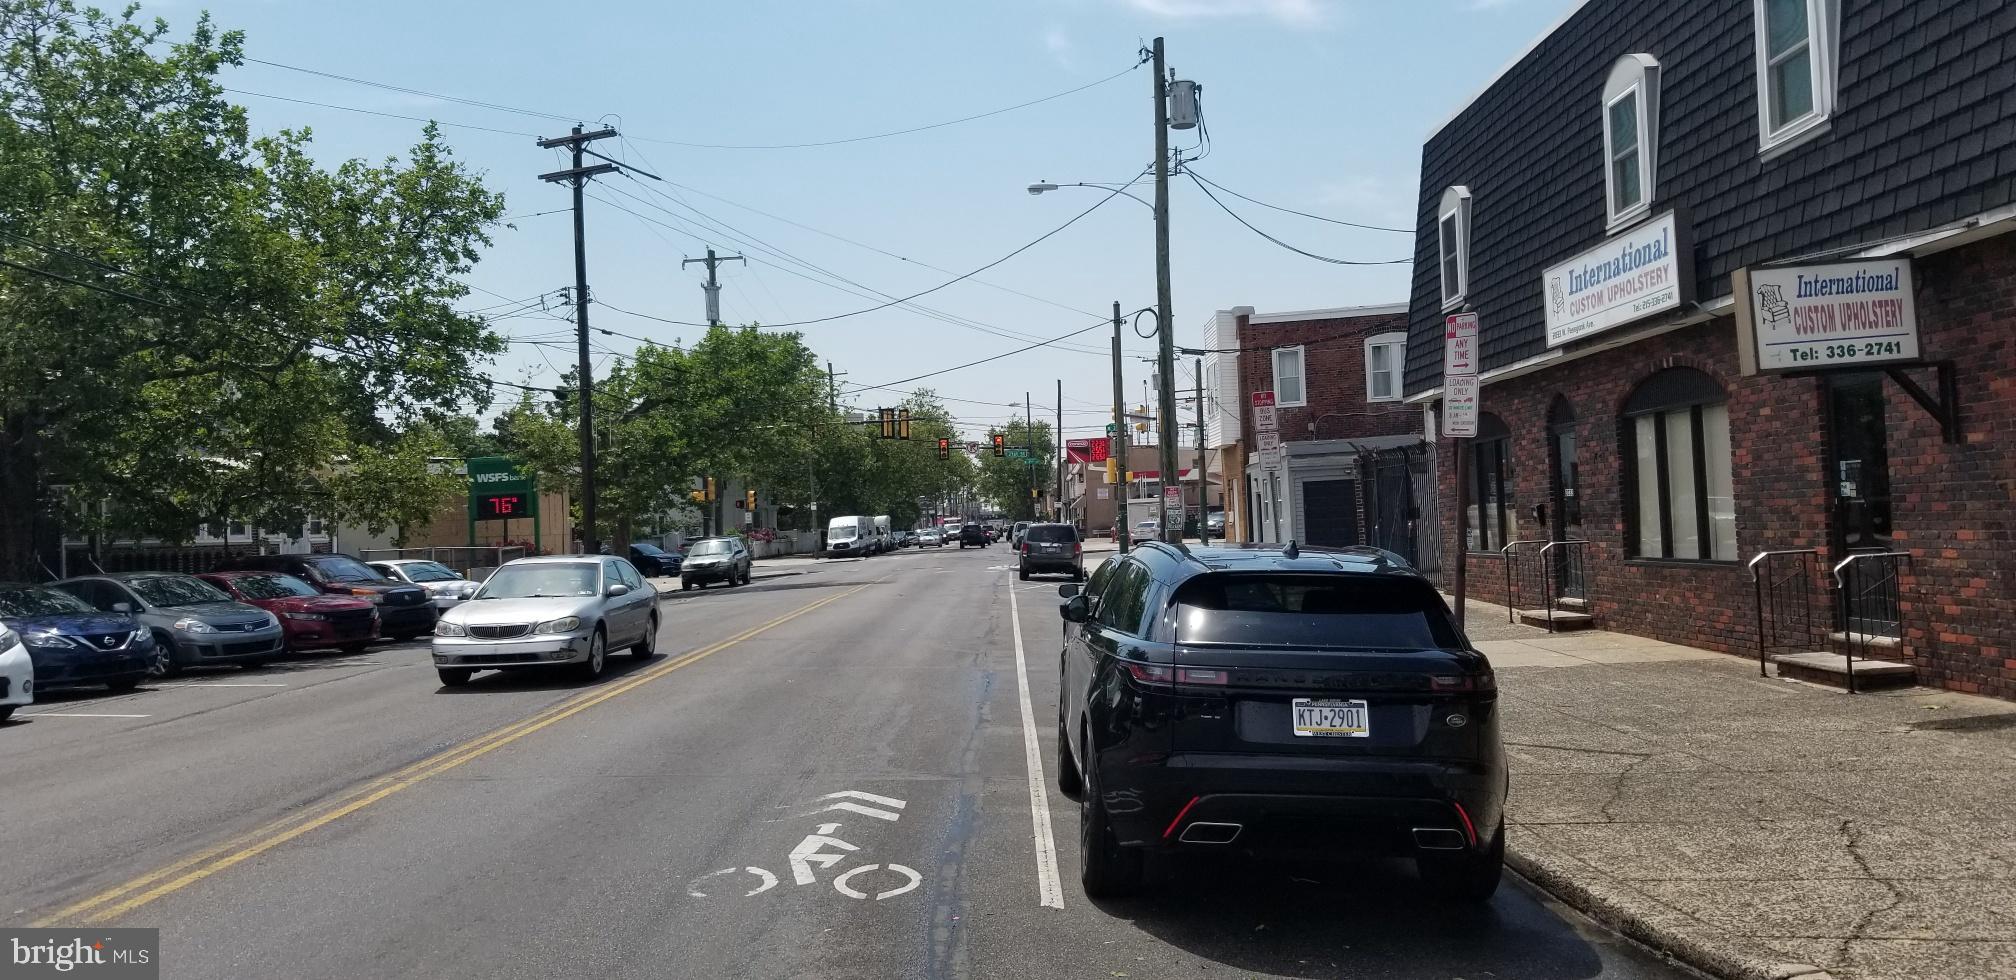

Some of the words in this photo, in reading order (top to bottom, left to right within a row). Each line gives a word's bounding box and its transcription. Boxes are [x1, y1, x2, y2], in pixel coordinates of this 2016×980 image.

[1568, 226, 1669, 296] International
[1796, 267, 1900, 298] International
[1569, 291, 1604, 318] CUSTOM
[1607, 263, 1670, 303] UPHOLSTERY
[1793, 304, 1837, 337] CUSTOM
[1838, 298, 1903, 332] UPHOLSTERY
[1448, 322, 1456, 336] NO
[1457, 321, 1476, 330] PARKING
[1455, 339, 1468, 349] ANY
[1790, 348, 1819, 362] Tel:
[1826, 341, 1902, 359] 336-2741
[1454, 350, 1470, 361] TIME
[1450, 378, 1474, 387] LOADING
[1453, 387, 1469, 396] ONLY
[476, 473, 509, 483] WSFS
